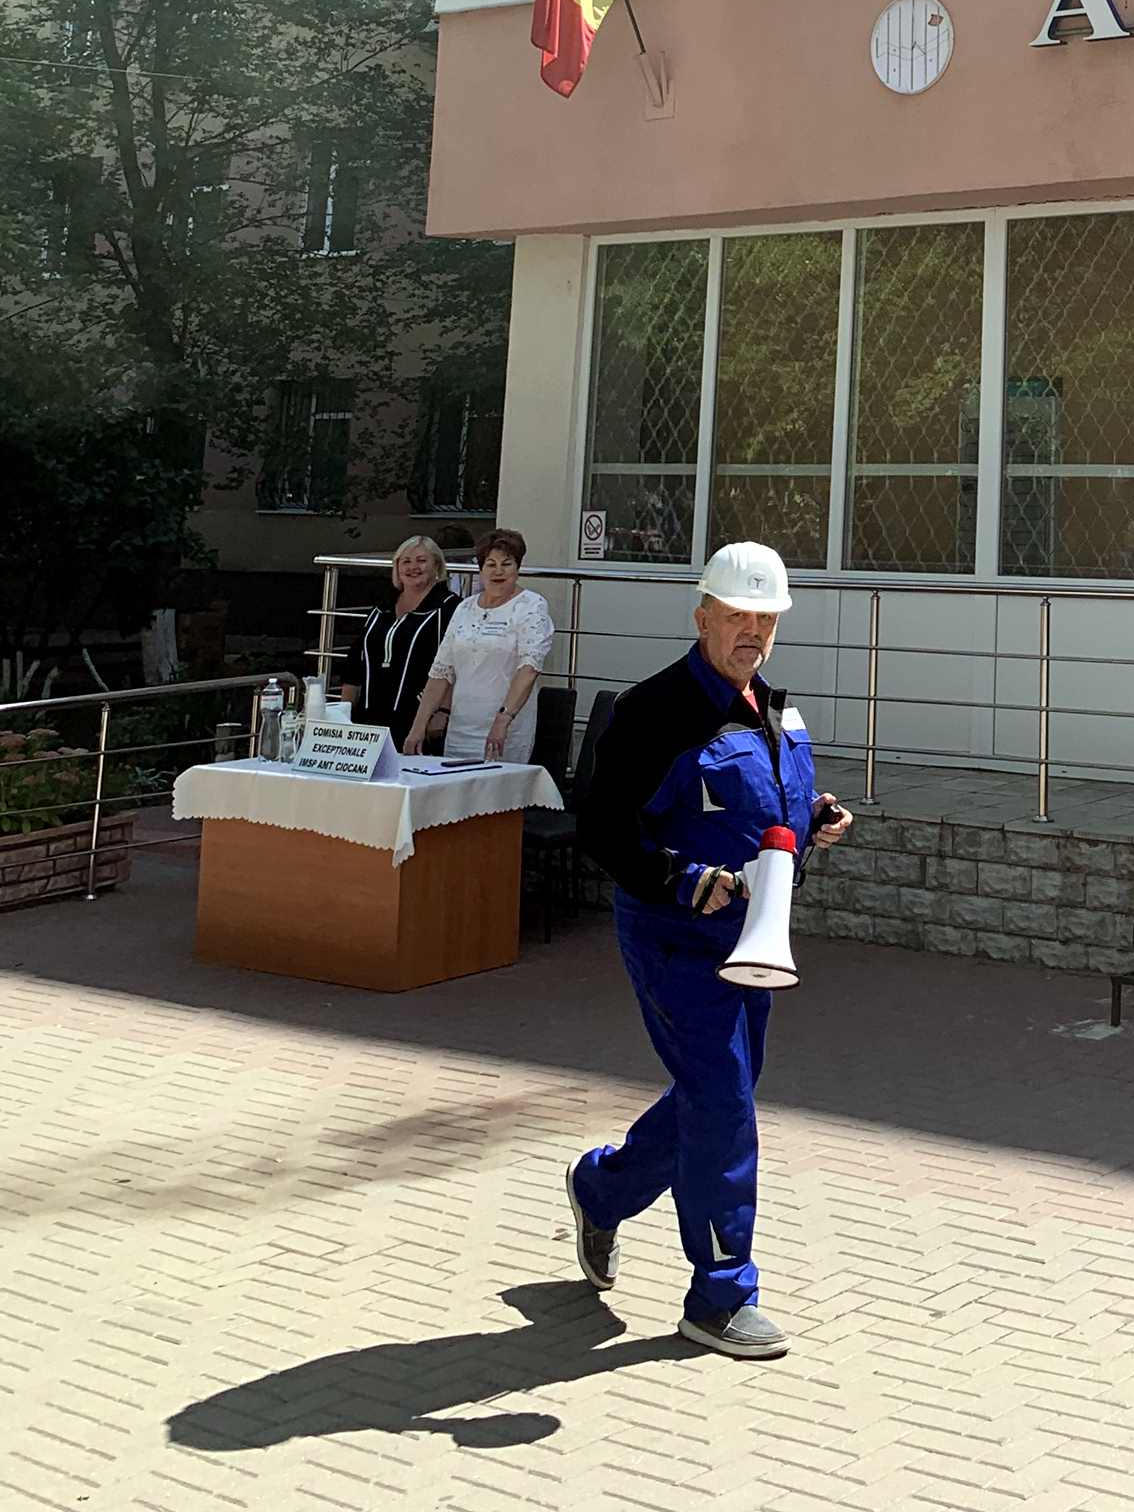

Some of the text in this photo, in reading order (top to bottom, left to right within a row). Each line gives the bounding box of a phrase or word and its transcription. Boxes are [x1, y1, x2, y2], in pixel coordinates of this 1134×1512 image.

[313, 727, 343, 738] COMISIA
[299, 758, 368, 774] IMSP AMT CIOCANA
